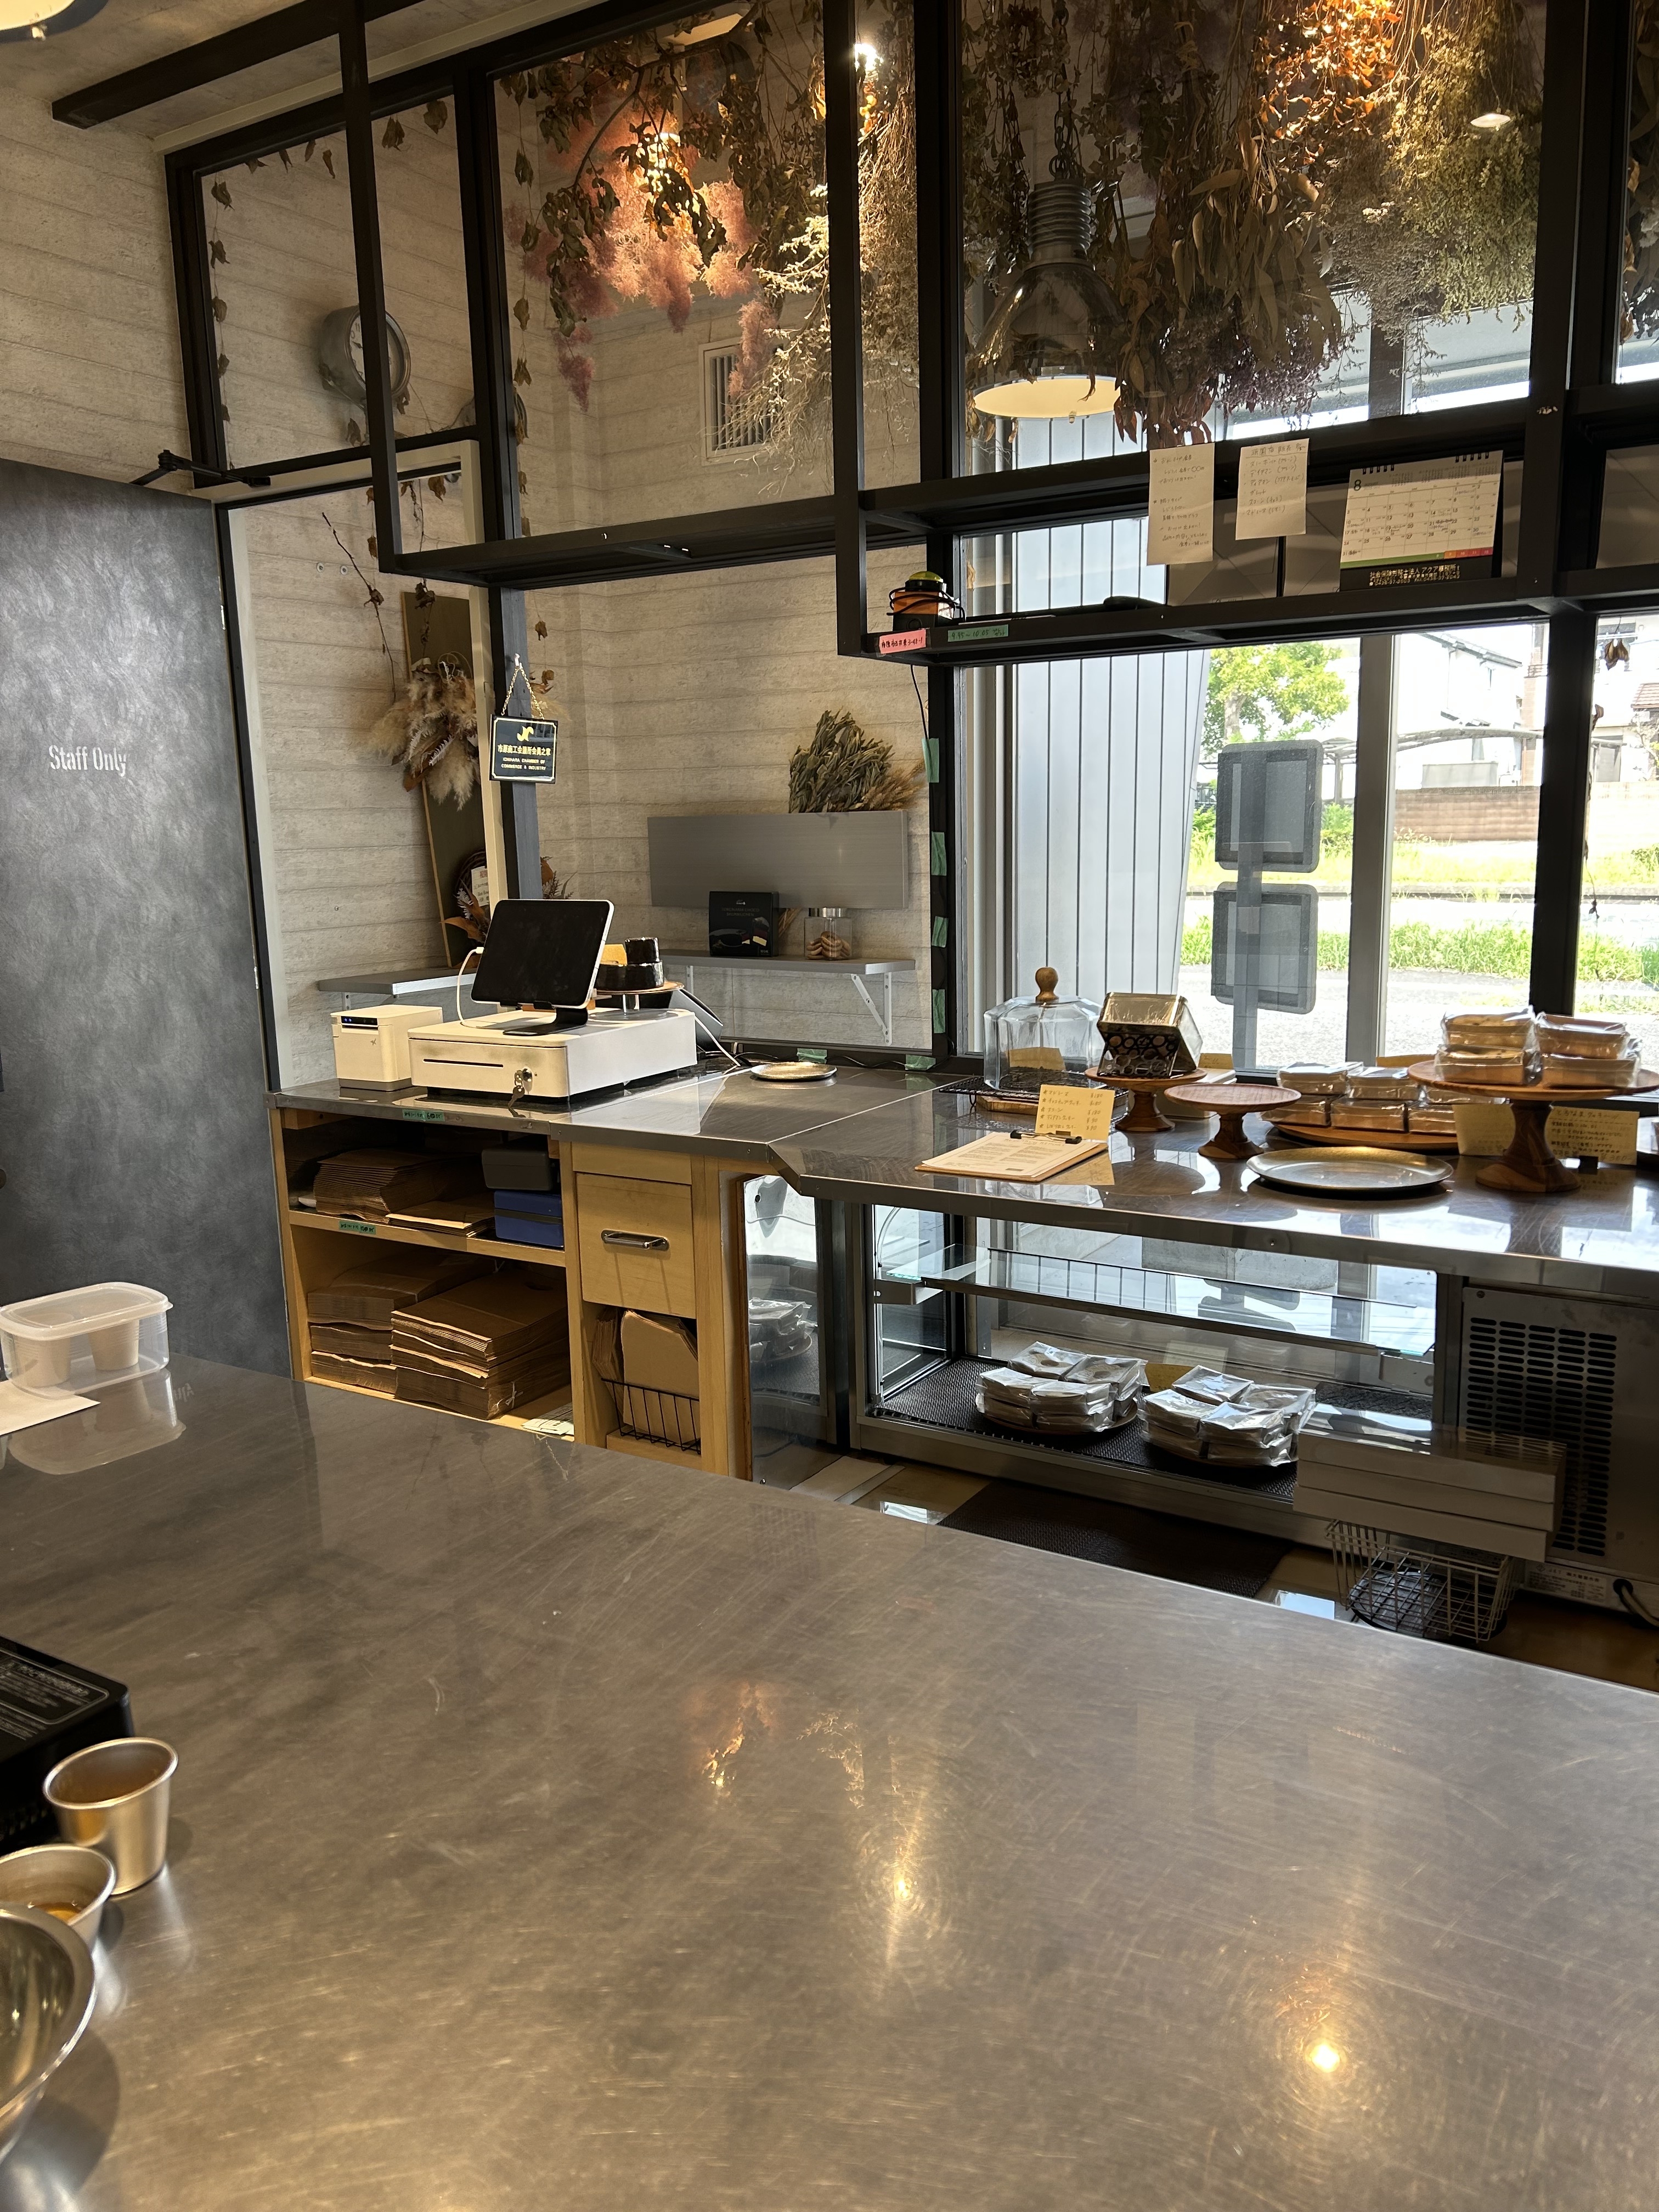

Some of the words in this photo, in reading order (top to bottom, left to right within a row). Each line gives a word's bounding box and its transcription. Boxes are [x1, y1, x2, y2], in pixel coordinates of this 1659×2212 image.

[1353, 479, 1361, 491] 8
[48, 744, 88, 770] Staff
[92, 747, 127, 777] Only
